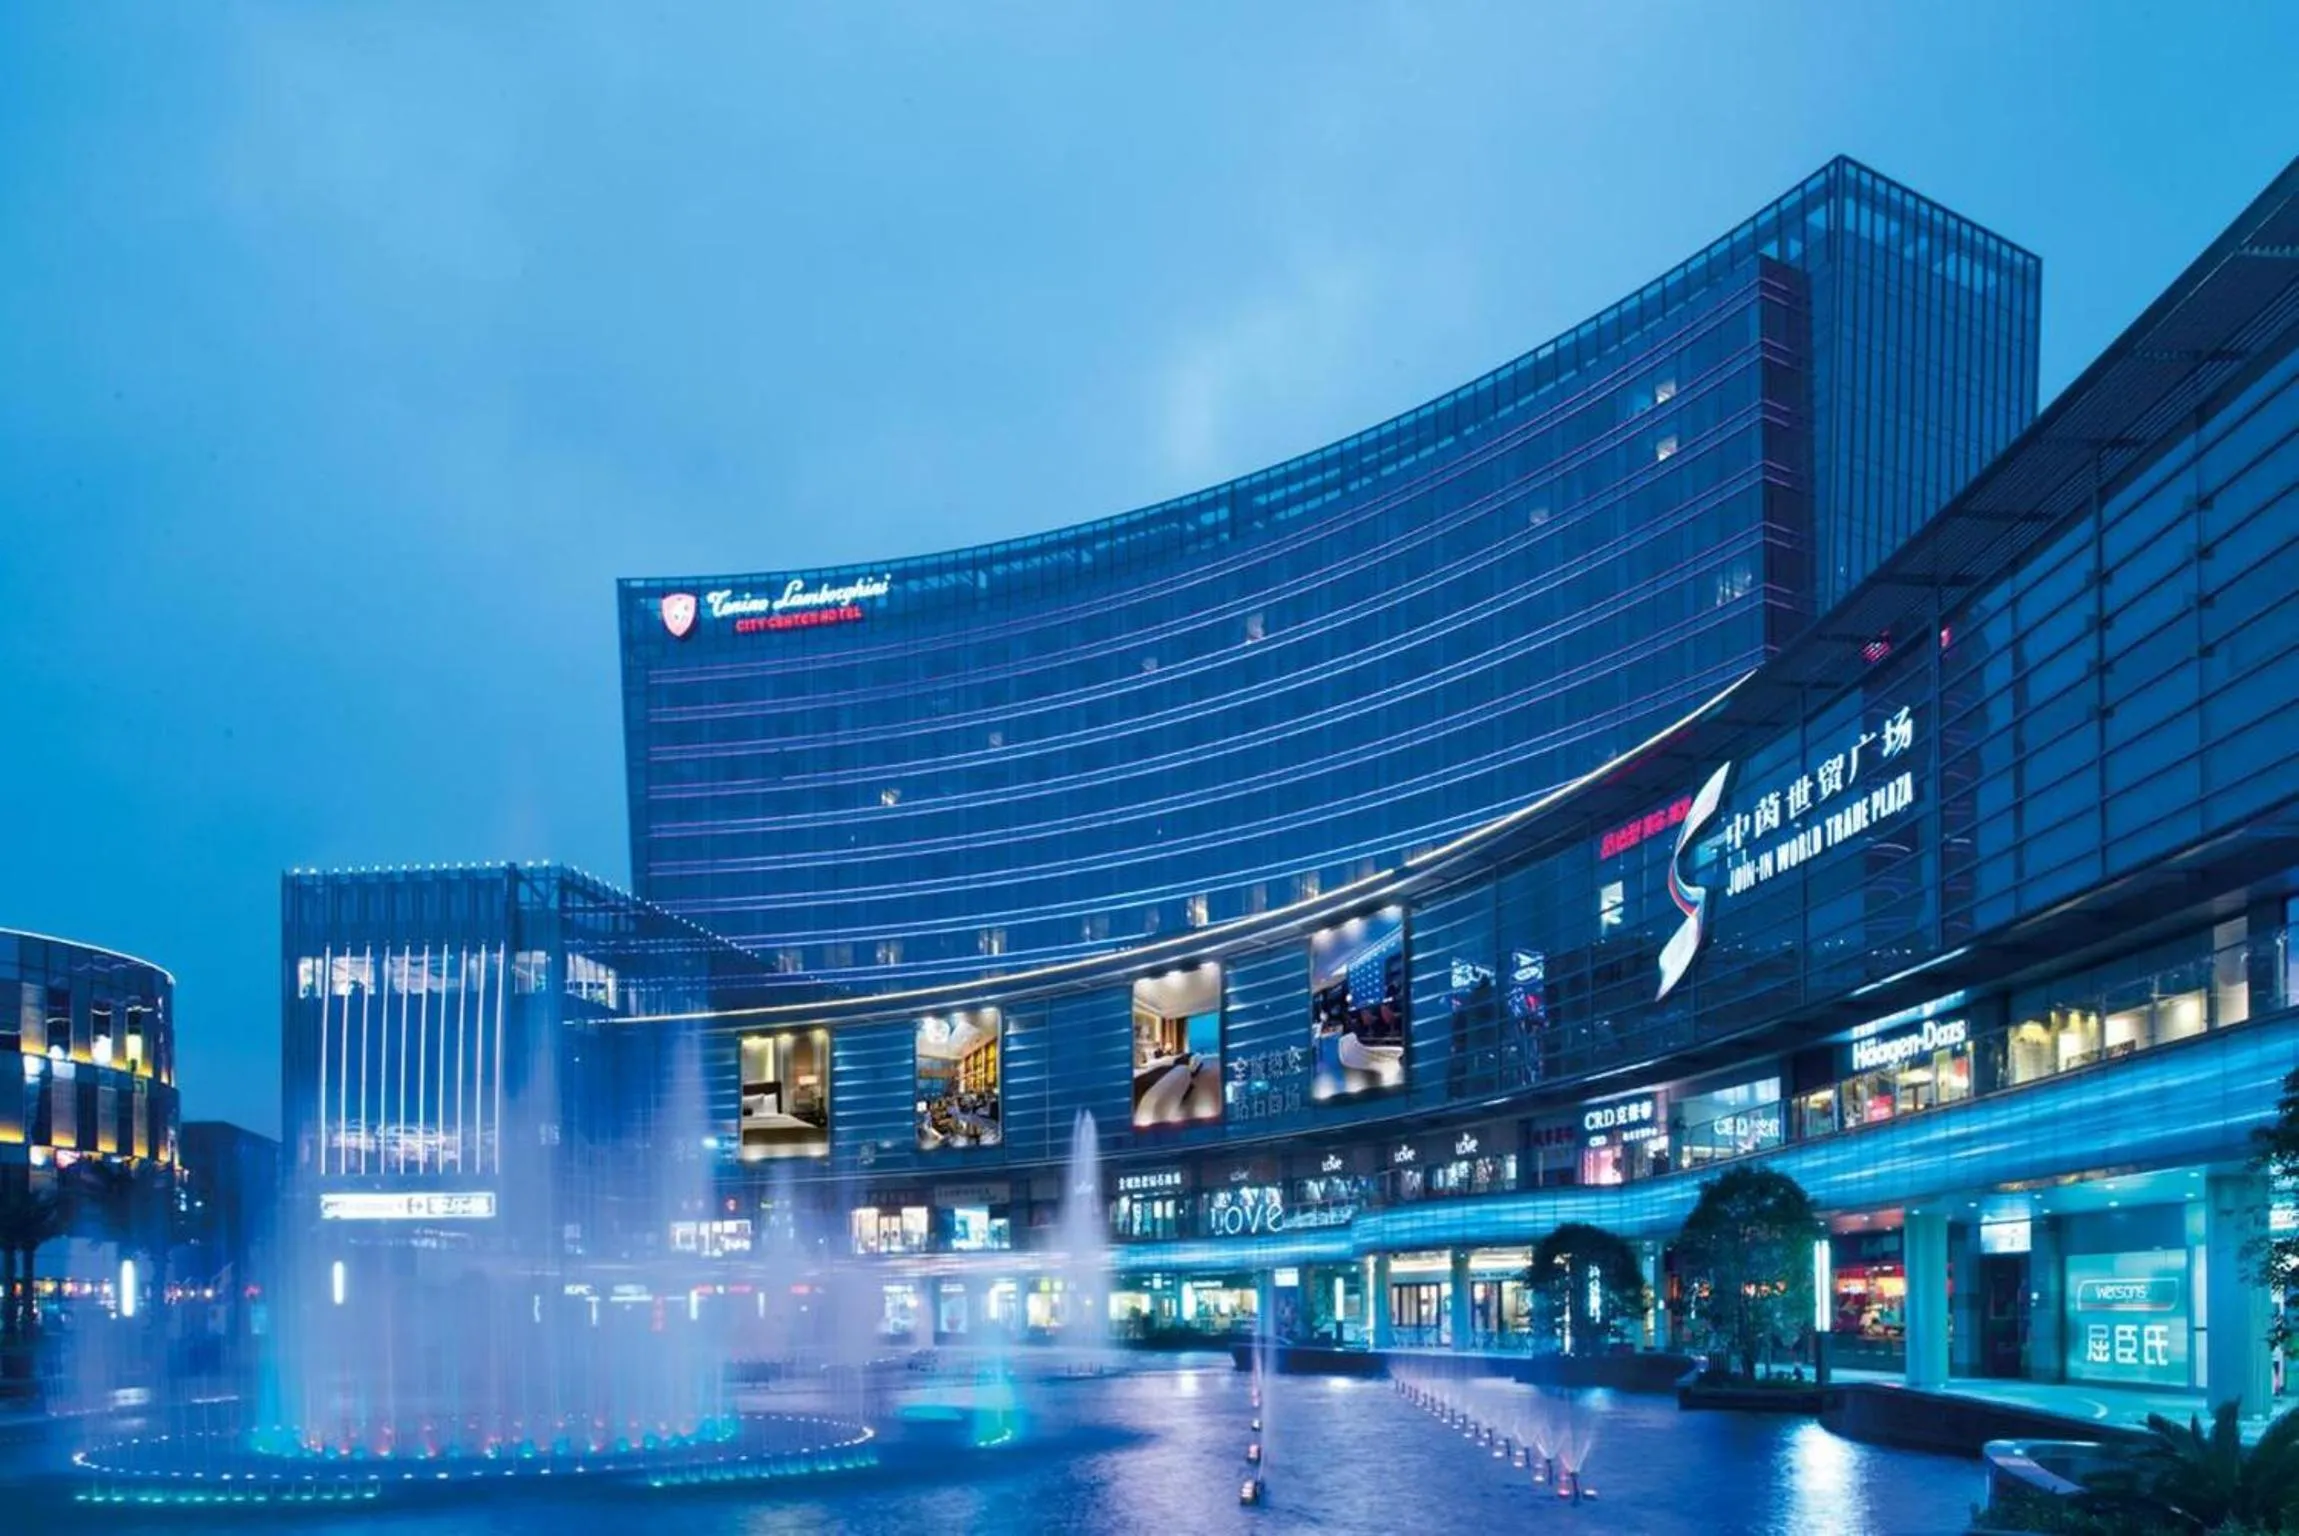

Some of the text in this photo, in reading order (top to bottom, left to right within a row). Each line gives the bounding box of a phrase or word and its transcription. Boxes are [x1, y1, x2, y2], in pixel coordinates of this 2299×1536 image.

[772, 573, 892, 610] Lamborghini
[735, 617, 766, 633] CITY
[819, 603, 864, 624] HOTEL
[1726, 706, 1913, 848] 中茵世贸广场
[1776, 826, 1822, 873] WORLD
[1825, 797, 1869, 847] TRADE
[1871, 771, 1914, 823] PLAZA
[2087, 1324, 2169, 1366] 屈臣氏
